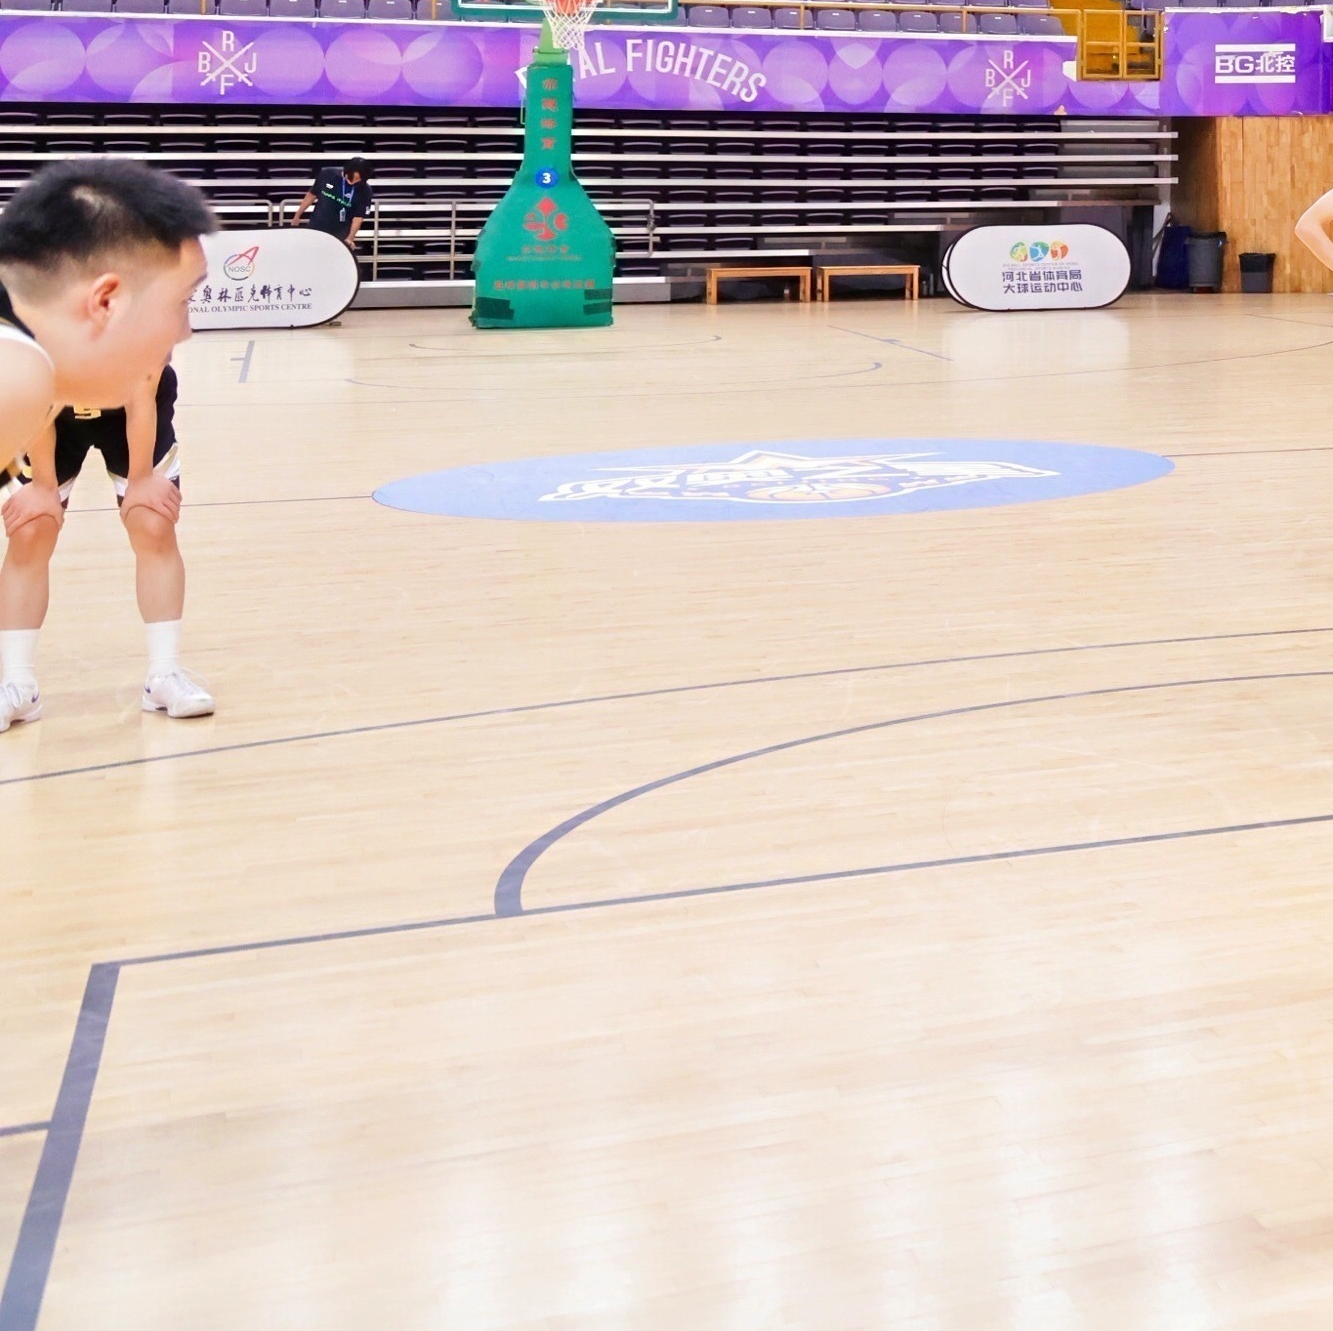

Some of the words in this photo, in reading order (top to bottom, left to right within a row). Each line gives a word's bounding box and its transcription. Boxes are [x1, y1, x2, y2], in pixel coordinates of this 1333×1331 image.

[626, 39, 767, 103] FIGHTERS
[1215, 55, 1296, 74] BG北控
[542, 172, 552, 184] 3
[1002, 269, 1083, 283] 河北省体育局
[1003, 281, 1083, 294] 大球运动中心
[211, 305, 248, 313] OLYMPIC
[249, 304, 280, 312] SPORTS
[280, 303, 312, 311] CENTRE
